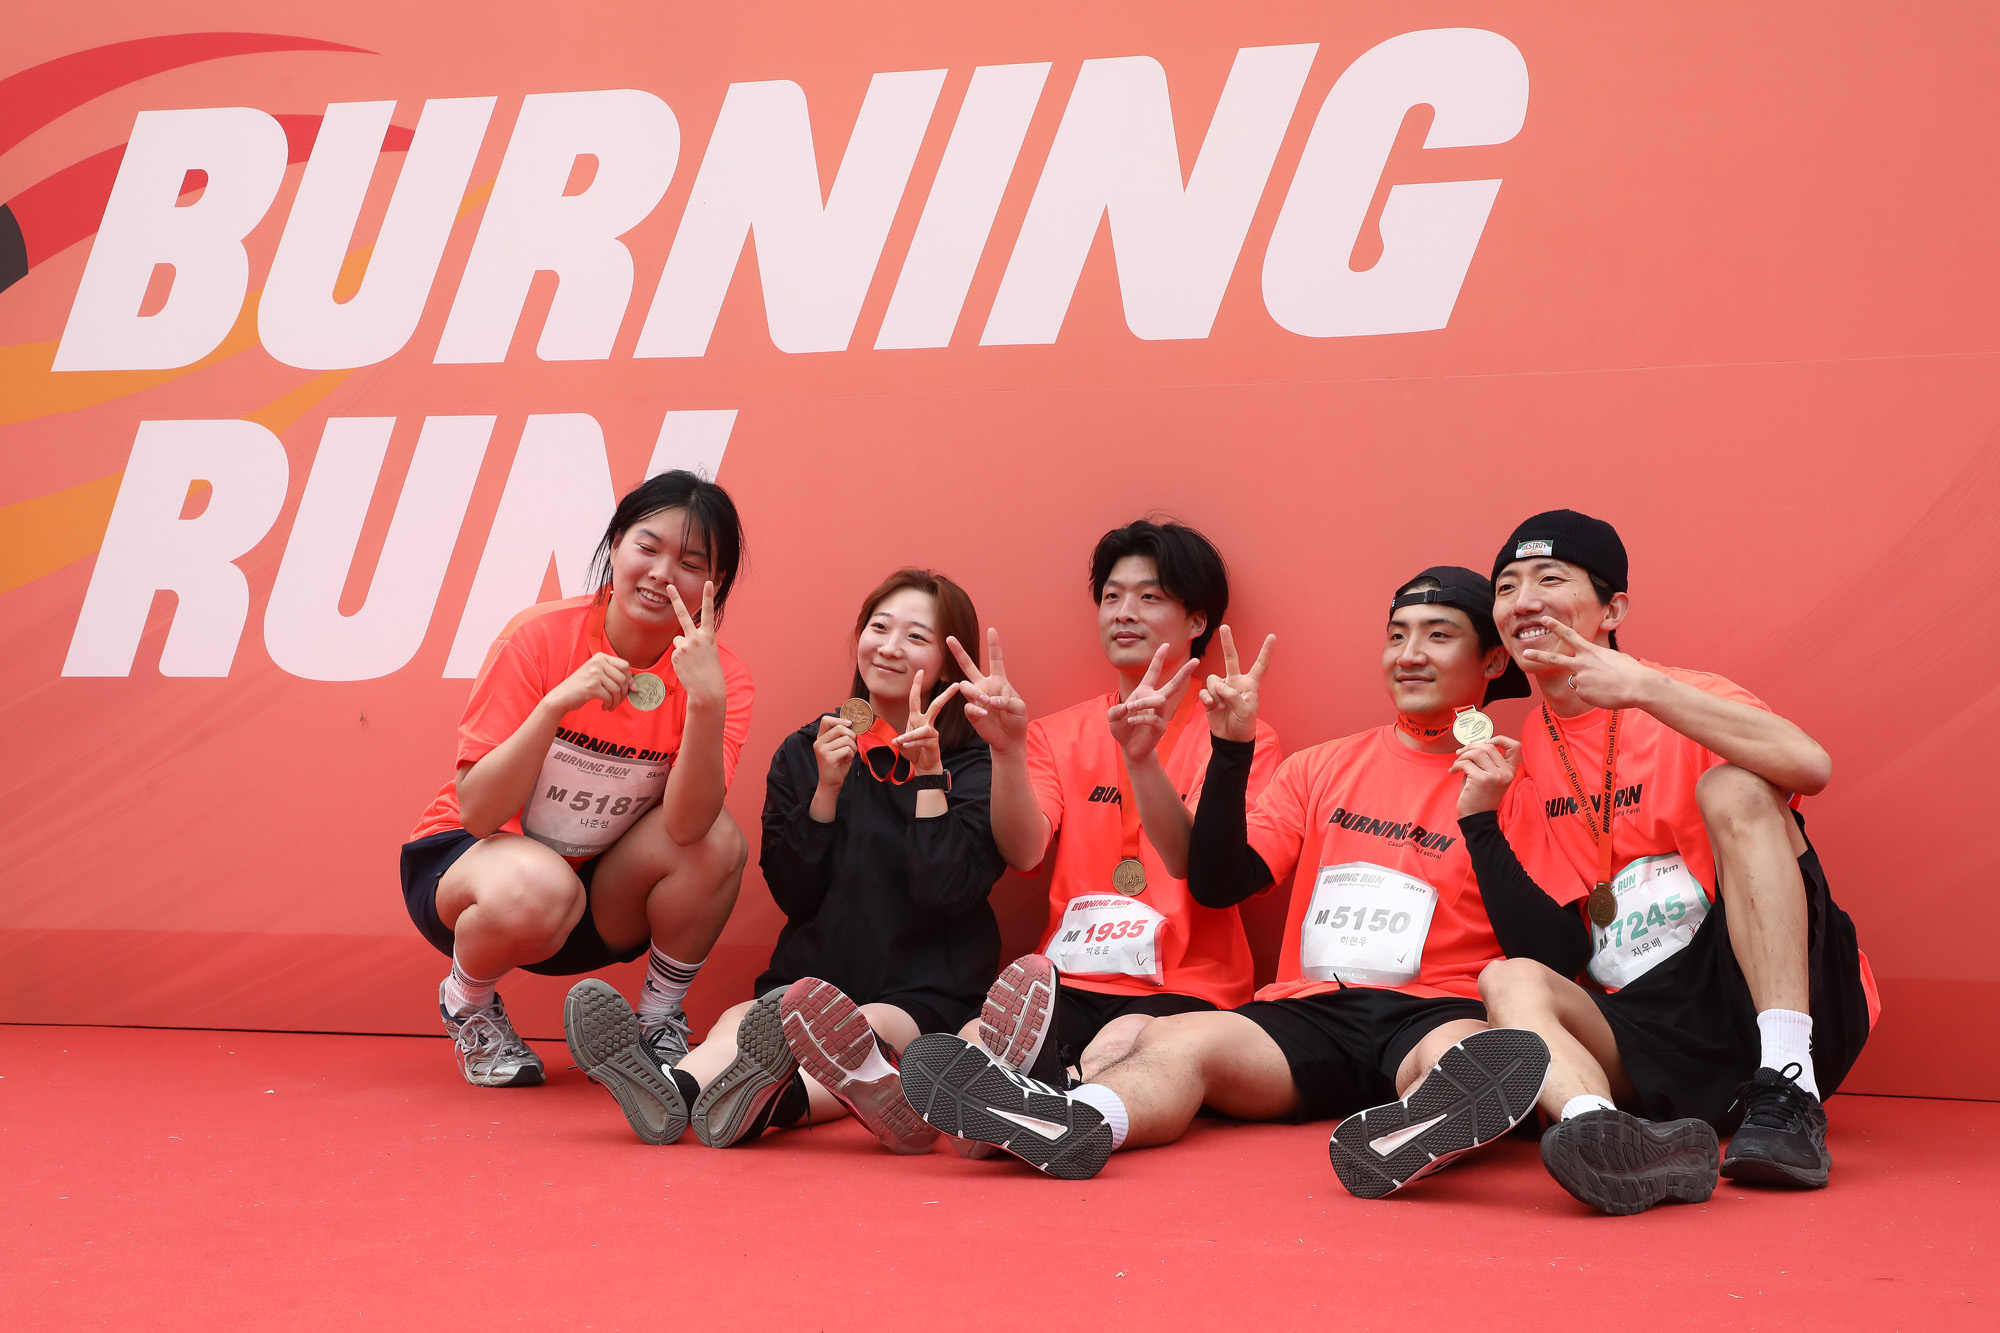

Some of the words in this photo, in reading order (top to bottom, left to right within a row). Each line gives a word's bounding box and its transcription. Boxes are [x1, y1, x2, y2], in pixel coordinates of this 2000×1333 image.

[51, 27, 1530, 372] BURNING
[61, 409, 739, 681] RUN
[1608, 709, 1619, 733] Runn
[1606, 735, 1616, 765] Casual
[553, 751, 605, 772] BURNING
[605, 765, 631, 776] RUN
[646, 771, 665, 779] 5km
[1548, 725, 1560, 741] RUN
[1557, 745, 1574, 772] Casual
[1569, 771, 1588, 807] Running
[1605, 770, 1613, 791] RUN
[545, 785, 568, 803] M
[569, 790, 652, 816] 5187
[1602, 792, 1612, 834] BURNING
[1407, 825, 1457, 852] RUN
[1419, 849, 1442, 859] Festival
[1323, 873, 1359, 885] BURNING
[1360, 873, 1387, 884] RUN
[1655, 863, 1679, 877] 7km
[1403, 882, 1426, 894] 5km
[1618, 873, 1636, 893] RUN
[1071, 899, 1111, 912] BURNING
[1110, 899, 1135, 907] RUN
[1061, 929, 1081, 943] M
[1084, 919, 1149, 944] 1935
[1314, 909, 1330, 926] M
[1330, 906, 1412, 934] 5150
[1610, 893, 1686, 948] 7245
[1631, 936, 1663, 957] 지우배
